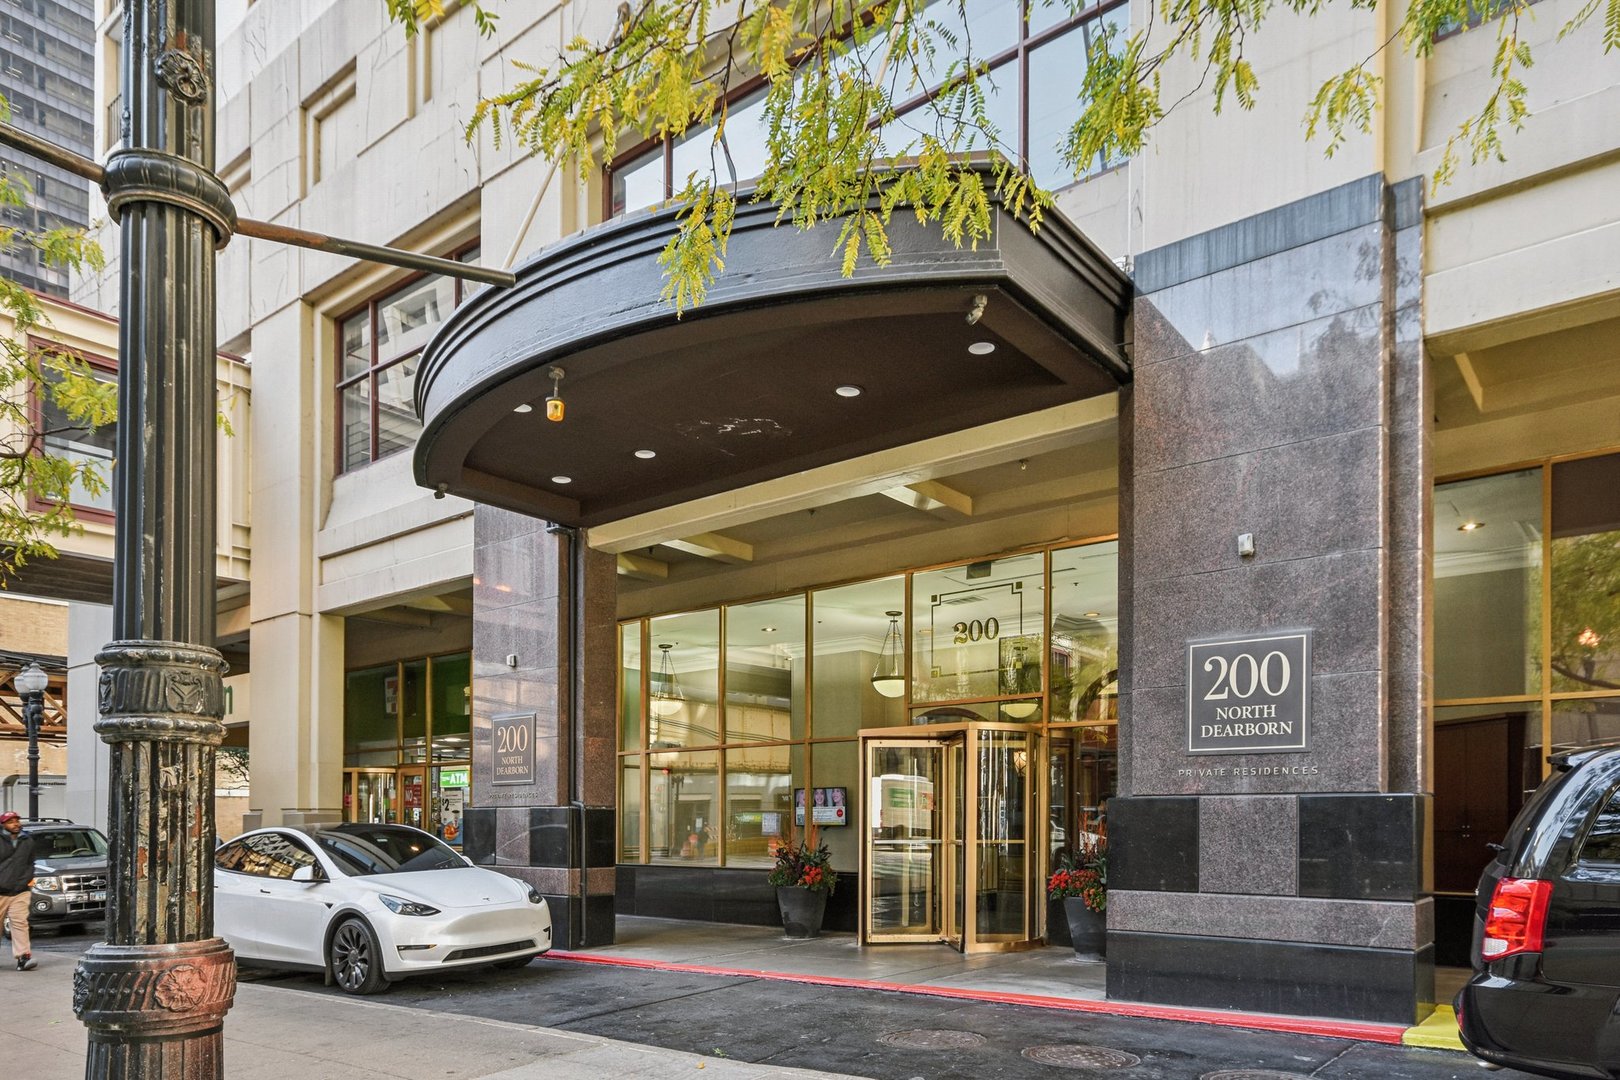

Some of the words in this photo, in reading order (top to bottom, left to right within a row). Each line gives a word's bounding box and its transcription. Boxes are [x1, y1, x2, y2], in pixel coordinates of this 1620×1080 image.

[953, 617, 999, 644] 200
[1204, 651, 1290, 700] 200
[1216, 704, 1276, 720] NORTH
[1201, 721, 1293, 738] DEARBORN
[497, 724, 528, 753] 200
[501, 756, 523, 765] NORTH
[496, 766, 529, 776] DEARBORN
[1178, 768, 1226, 777] PRIVATE
[1233, 766, 1319, 776] RESIDENCES
[450, 773, 468, 784] ATM
[441, 798, 450, 811] $2
